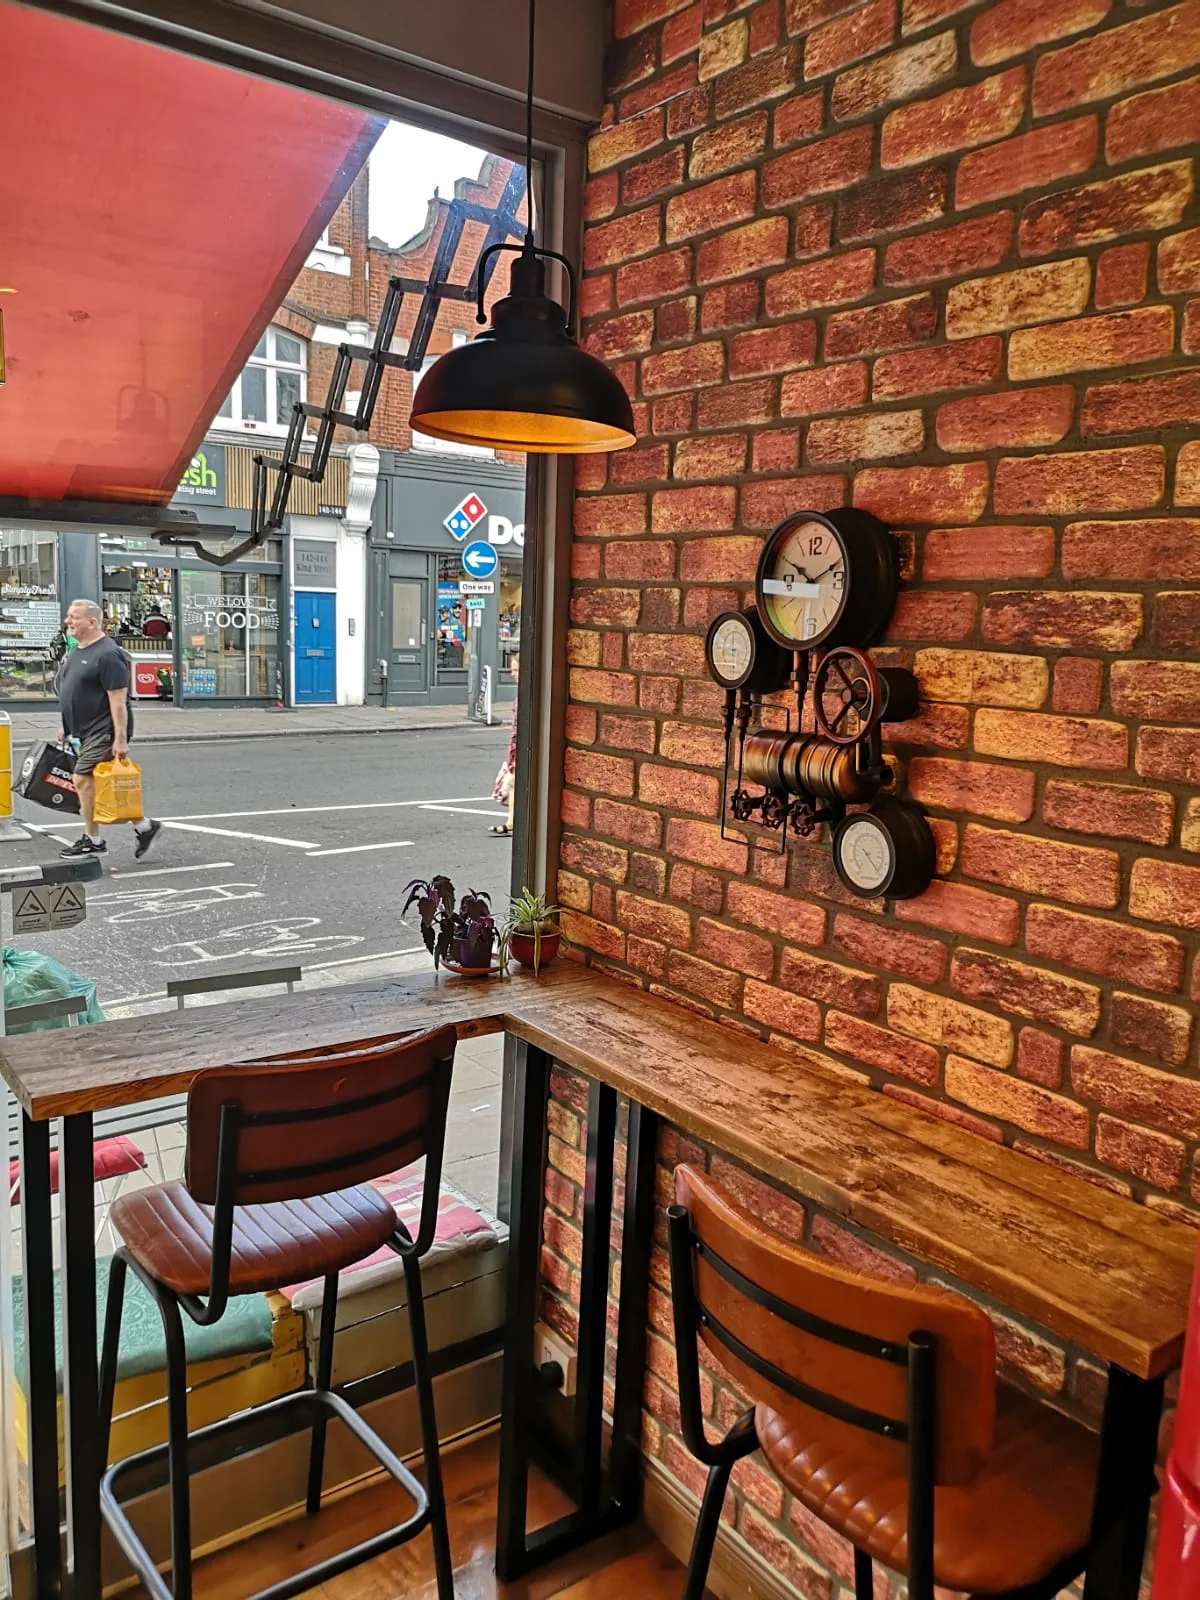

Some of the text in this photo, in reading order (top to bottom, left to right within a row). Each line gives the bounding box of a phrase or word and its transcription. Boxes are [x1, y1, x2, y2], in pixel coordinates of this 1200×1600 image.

[808, 536, 823, 556] 12
[478, 584, 491, 592] way
[833, 571, 844, 590] 3
[207, 596, 255, 607] WE LOVE
[204, 612, 260, 629] FOOD
